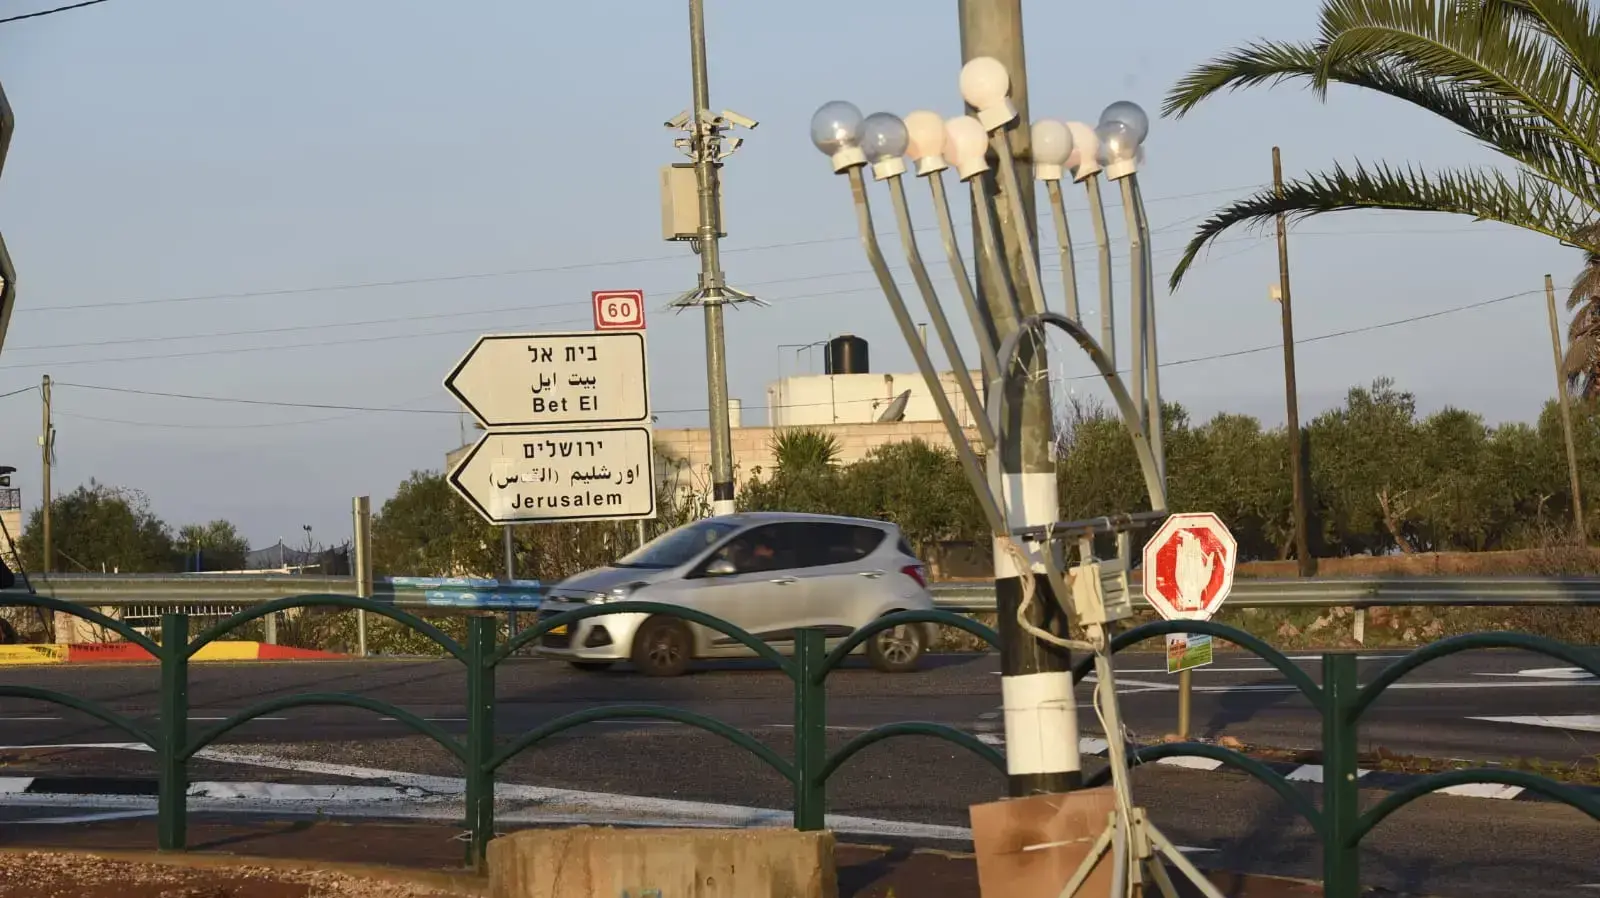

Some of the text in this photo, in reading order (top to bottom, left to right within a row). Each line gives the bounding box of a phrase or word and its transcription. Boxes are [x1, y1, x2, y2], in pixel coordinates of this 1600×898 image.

[608, 303, 631, 318] 60
[527, 345, 598, 363] בית אל
[531, 372, 597, 394] بيت ايل
[532, 395, 598, 413] Bet El
[523, 440, 603, 459] ירושלים
[489, 467, 559, 490] (الس)
[511, 491, 622, 510] Jerusalem
